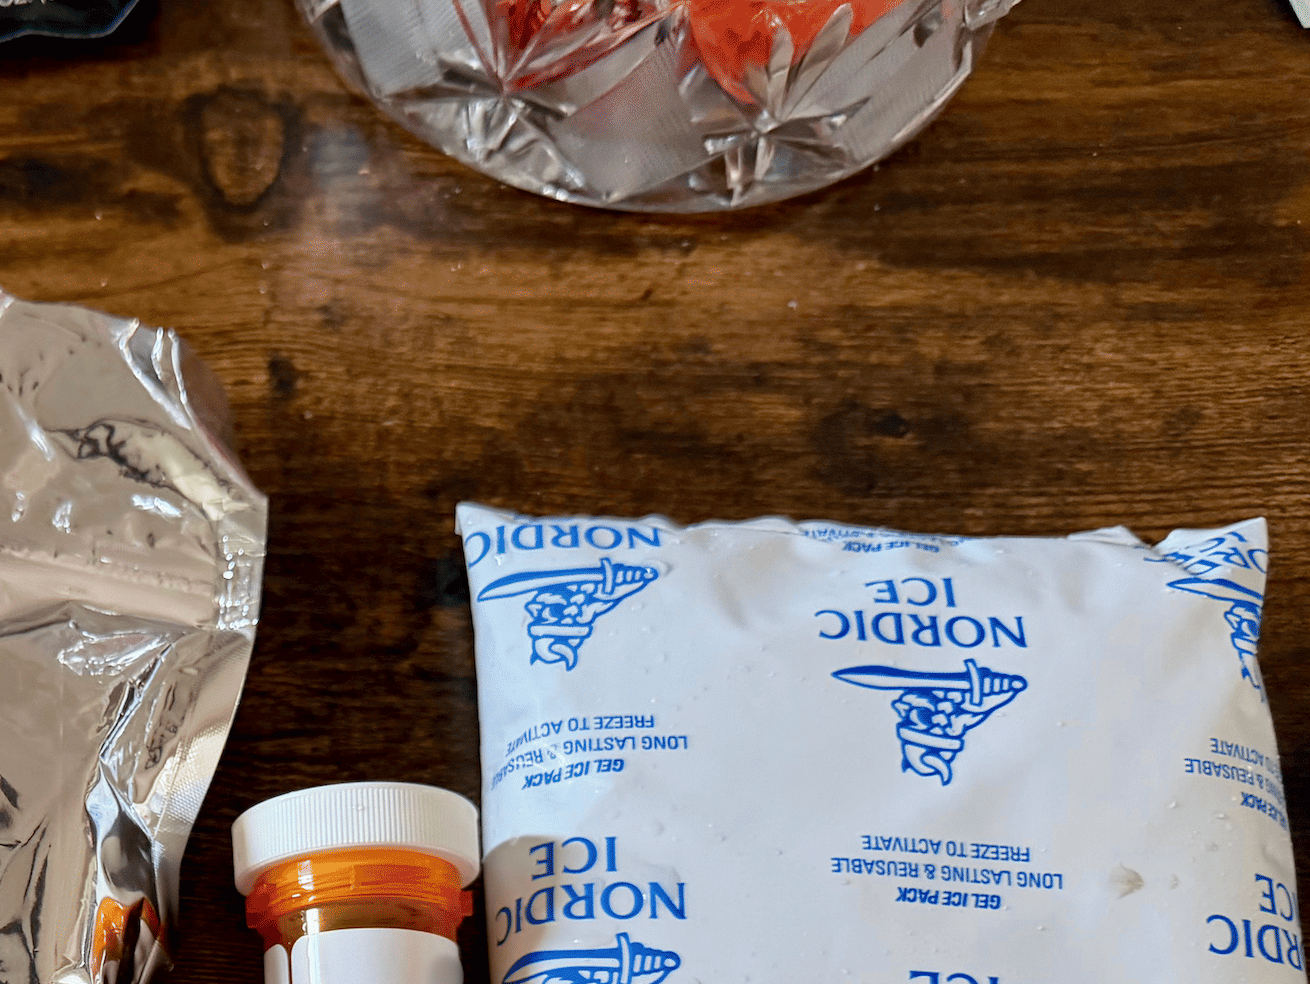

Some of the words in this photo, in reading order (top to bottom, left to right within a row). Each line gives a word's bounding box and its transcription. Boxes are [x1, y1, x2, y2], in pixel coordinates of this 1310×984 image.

[464, 524, 662, 569] NORDIC
[842, 541, 882, 553] PACK
[864, 577, 957, 608] ICE
[814, 610, 1028, 649] NORDIC
[568, 717, 590, 732] TO
[593, 715, 655, 730] FREEZE
[505, 720, 563, 757] ACTIVATE
[563, 736, 635, 755] LASTING
[641, 735, 688, 750] LONG
[1209, 738, 1264, 767] ACTIVATE
[565, 760, 591, 780] ICE
[593, 758, 625, 773] GEL
[1184, 758, 1255, 786] REUSABLE
[521, 768, 563, 790] PACK
[861, 835, 941, 855] ACTIVATE
[946, 840, 967, 857] TO
[970, 843, 1030, 862] FREEZE
[529, 836, 617, 881] ICE
[830, 857, 919, 878] REUSABLE
[924, 864, 936, 879] &
[941, 865, 1011, 886] LASTING
[1017, 872, 1063, 889] LONG
[895, 887, 939, 904] PACK
[943, 891, 968, 907] ICE
[972, 894, 1001, 910] GEL
[495, 882, 687, 946] NORDIC
[1206, 914, 1303, 972] RDIC
